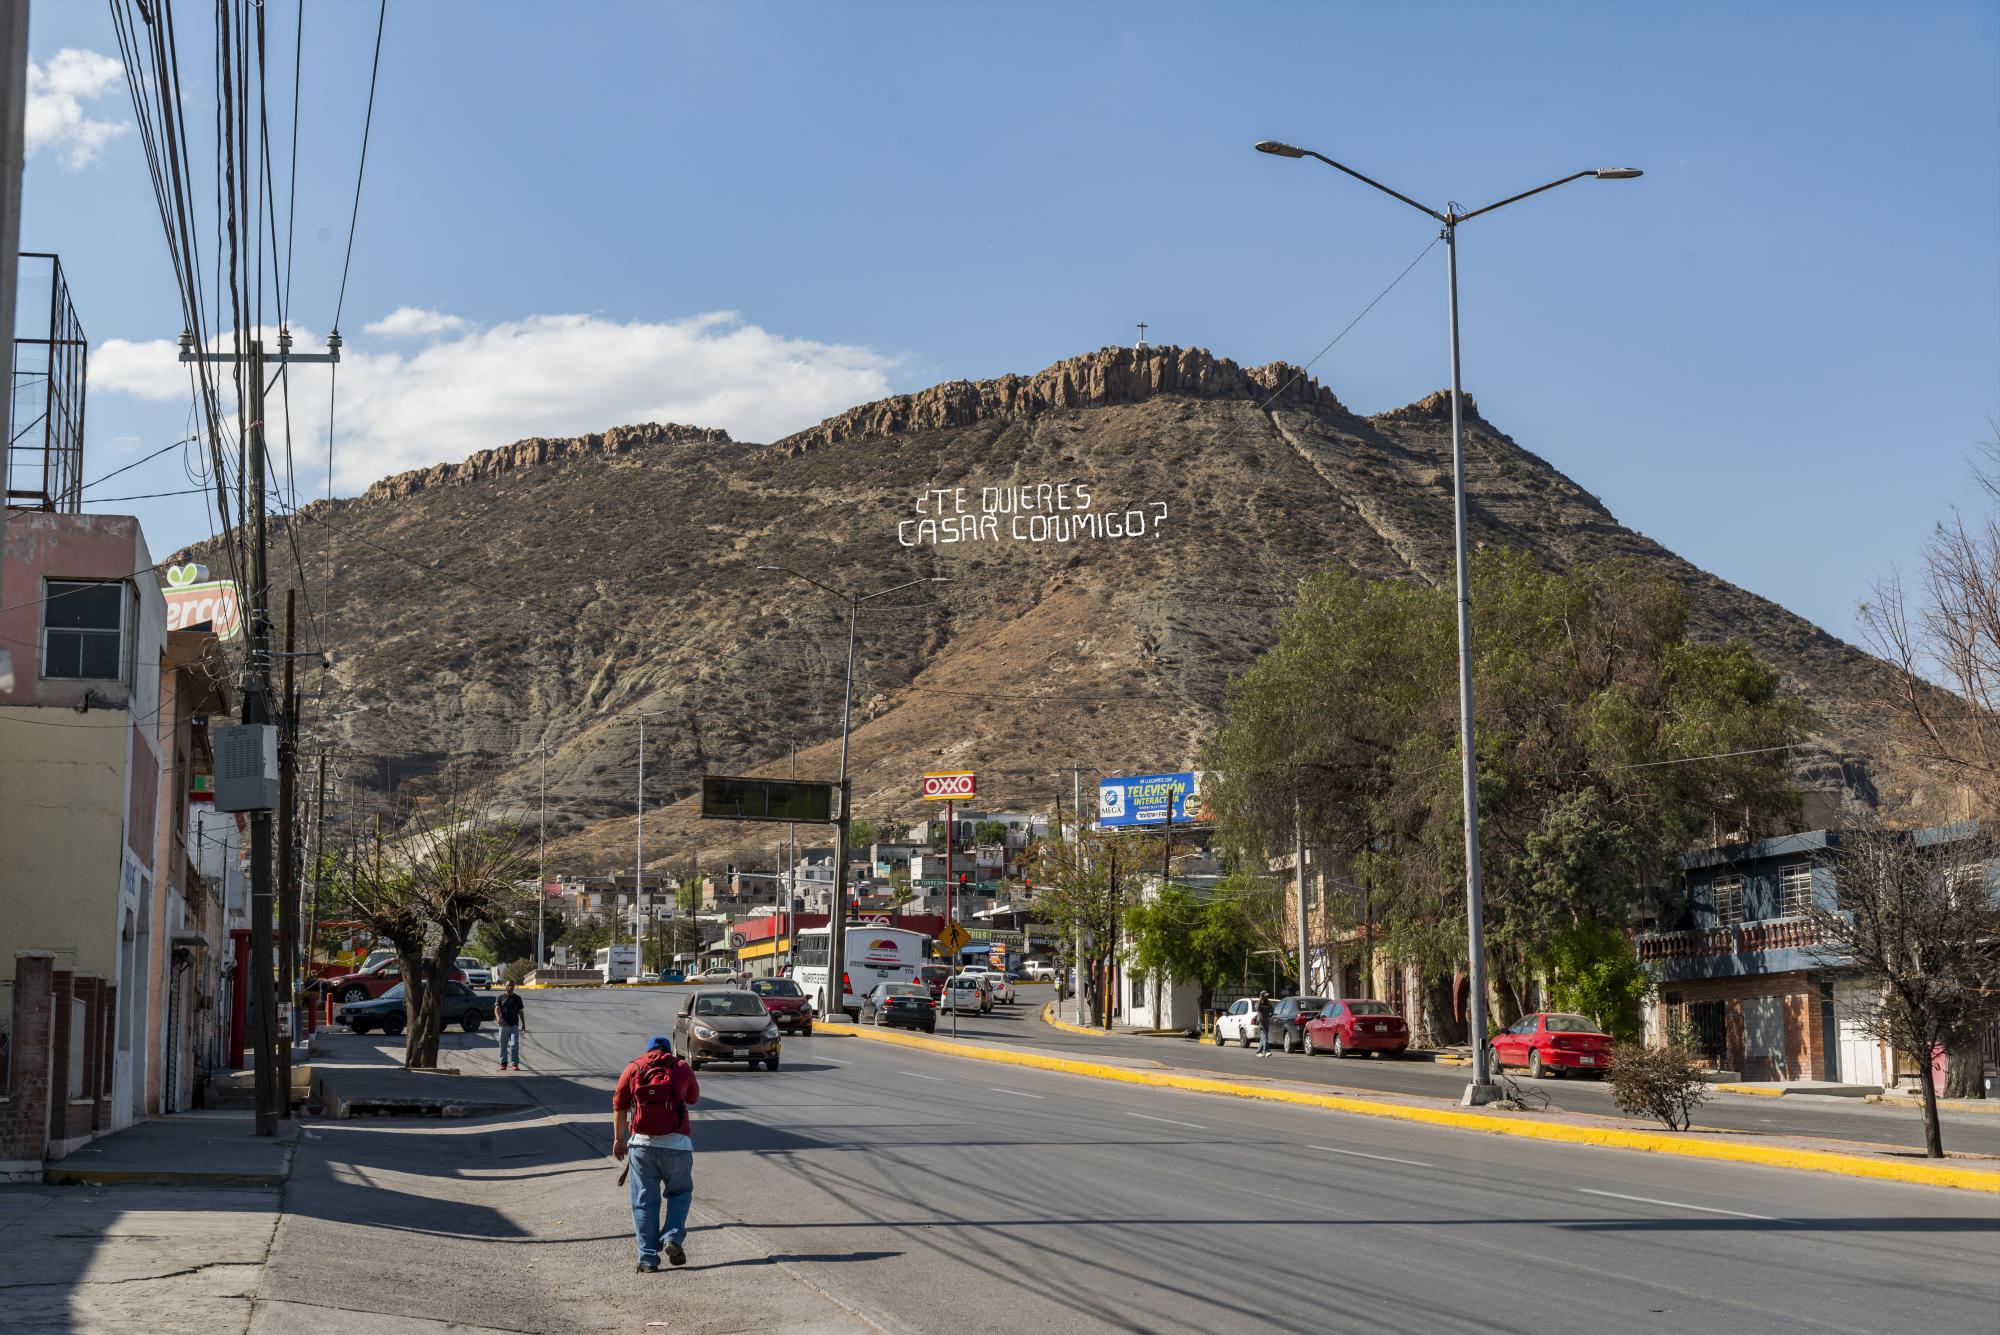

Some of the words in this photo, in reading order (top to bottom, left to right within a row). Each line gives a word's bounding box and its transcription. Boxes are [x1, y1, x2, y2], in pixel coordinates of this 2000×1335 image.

[982, 483, 1091, 517] QUIERES
[898, 514, 999, 547] CASAR
[925, 776, 972, 795] OXXO
[1127, 780, 1185, 798] TELEVISIÓN
[1101, 806, 1122, 814] MEGA
